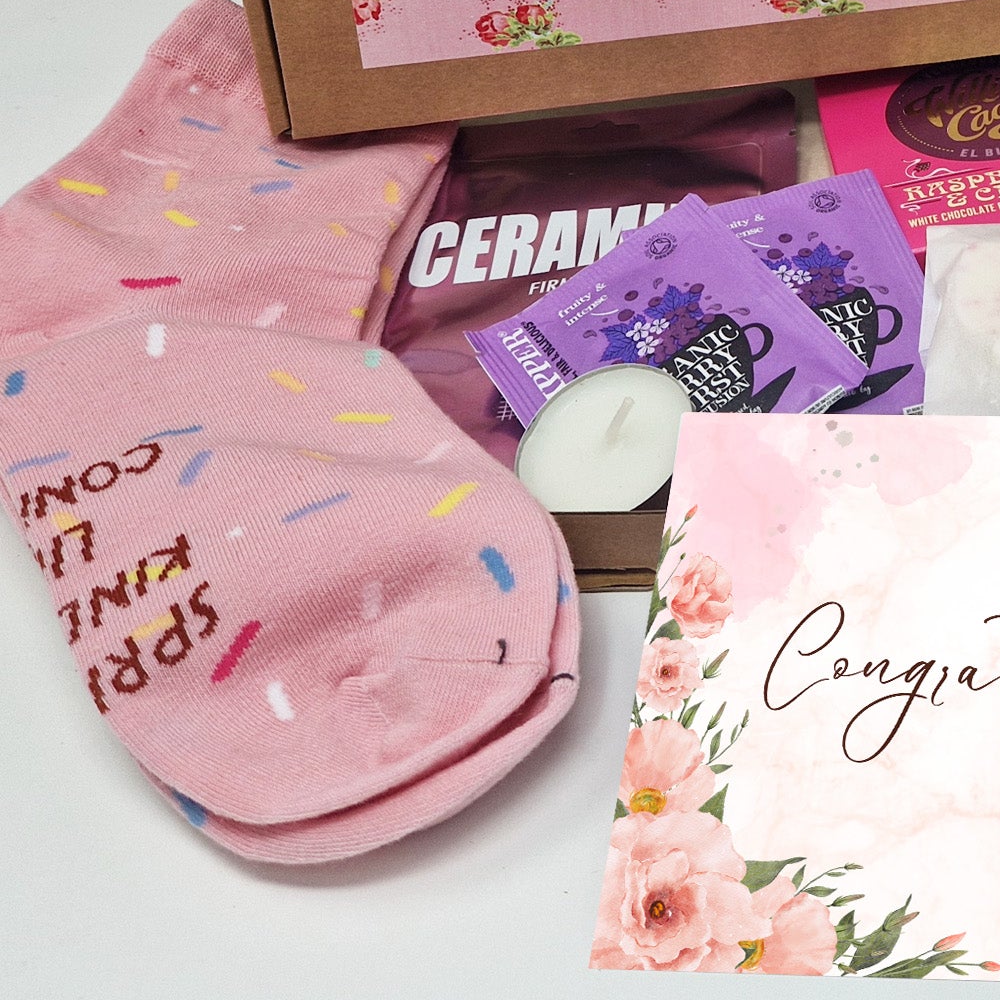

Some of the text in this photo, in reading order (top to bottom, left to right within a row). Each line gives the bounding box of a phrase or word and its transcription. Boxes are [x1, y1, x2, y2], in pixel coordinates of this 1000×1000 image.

[960, 148, 978, 158] EL
[947, 193, 968, 208] &
[908, 215, 940, 228] WHITE
[941, 204, 997, 222] CHOCOLATE
[558, 283, 607, 318] fruity &
[565, 295, 608, 326] intense
